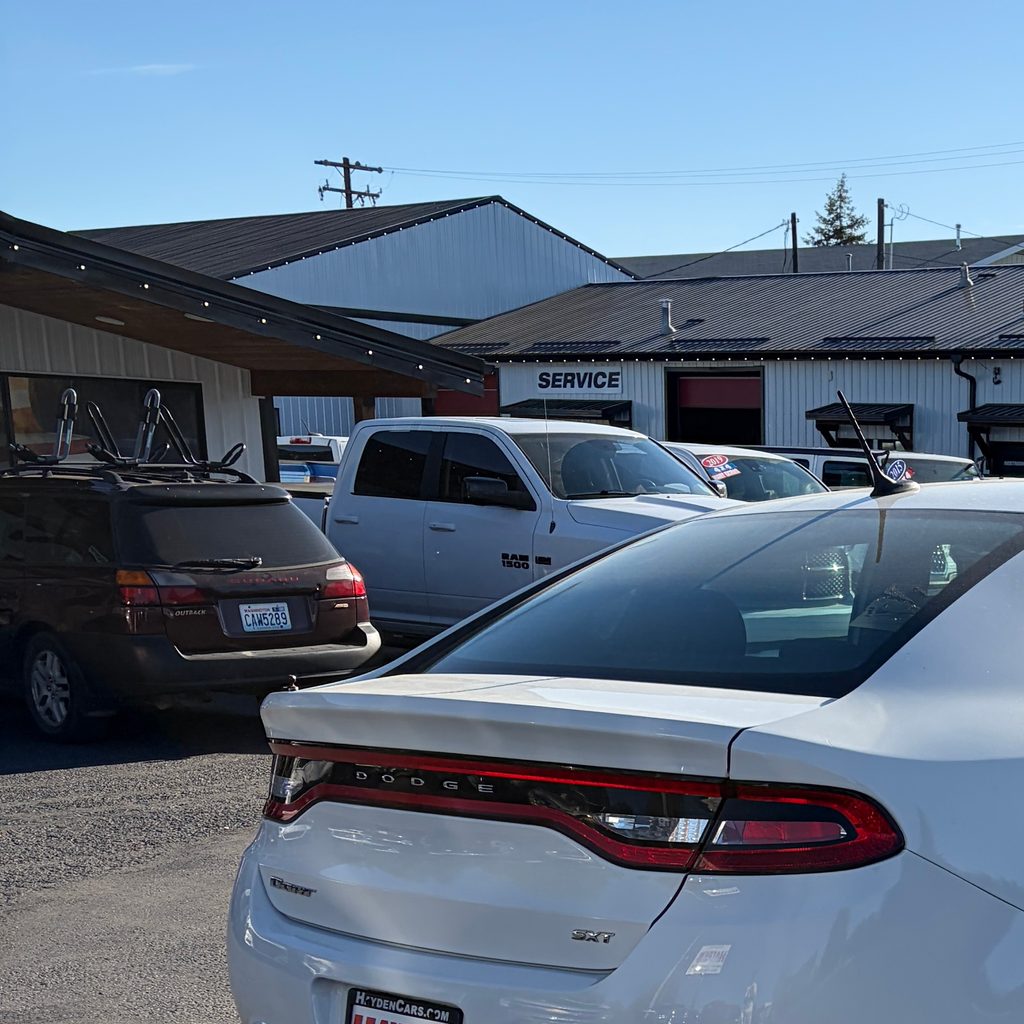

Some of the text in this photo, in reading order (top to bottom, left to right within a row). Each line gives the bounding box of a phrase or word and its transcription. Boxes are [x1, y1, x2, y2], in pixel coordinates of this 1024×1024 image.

[538, 371, 620, 389] SERVICE
[502, 553, 529, 561] RAM
[502, 560, 529, 569] 1500
[175, 609, 206, 617] OUTBACK
[244, 612, 288, 628] CAW5289
[356, 771, 494, 793] DODGE
[571, 929, 615, 943] SXT
